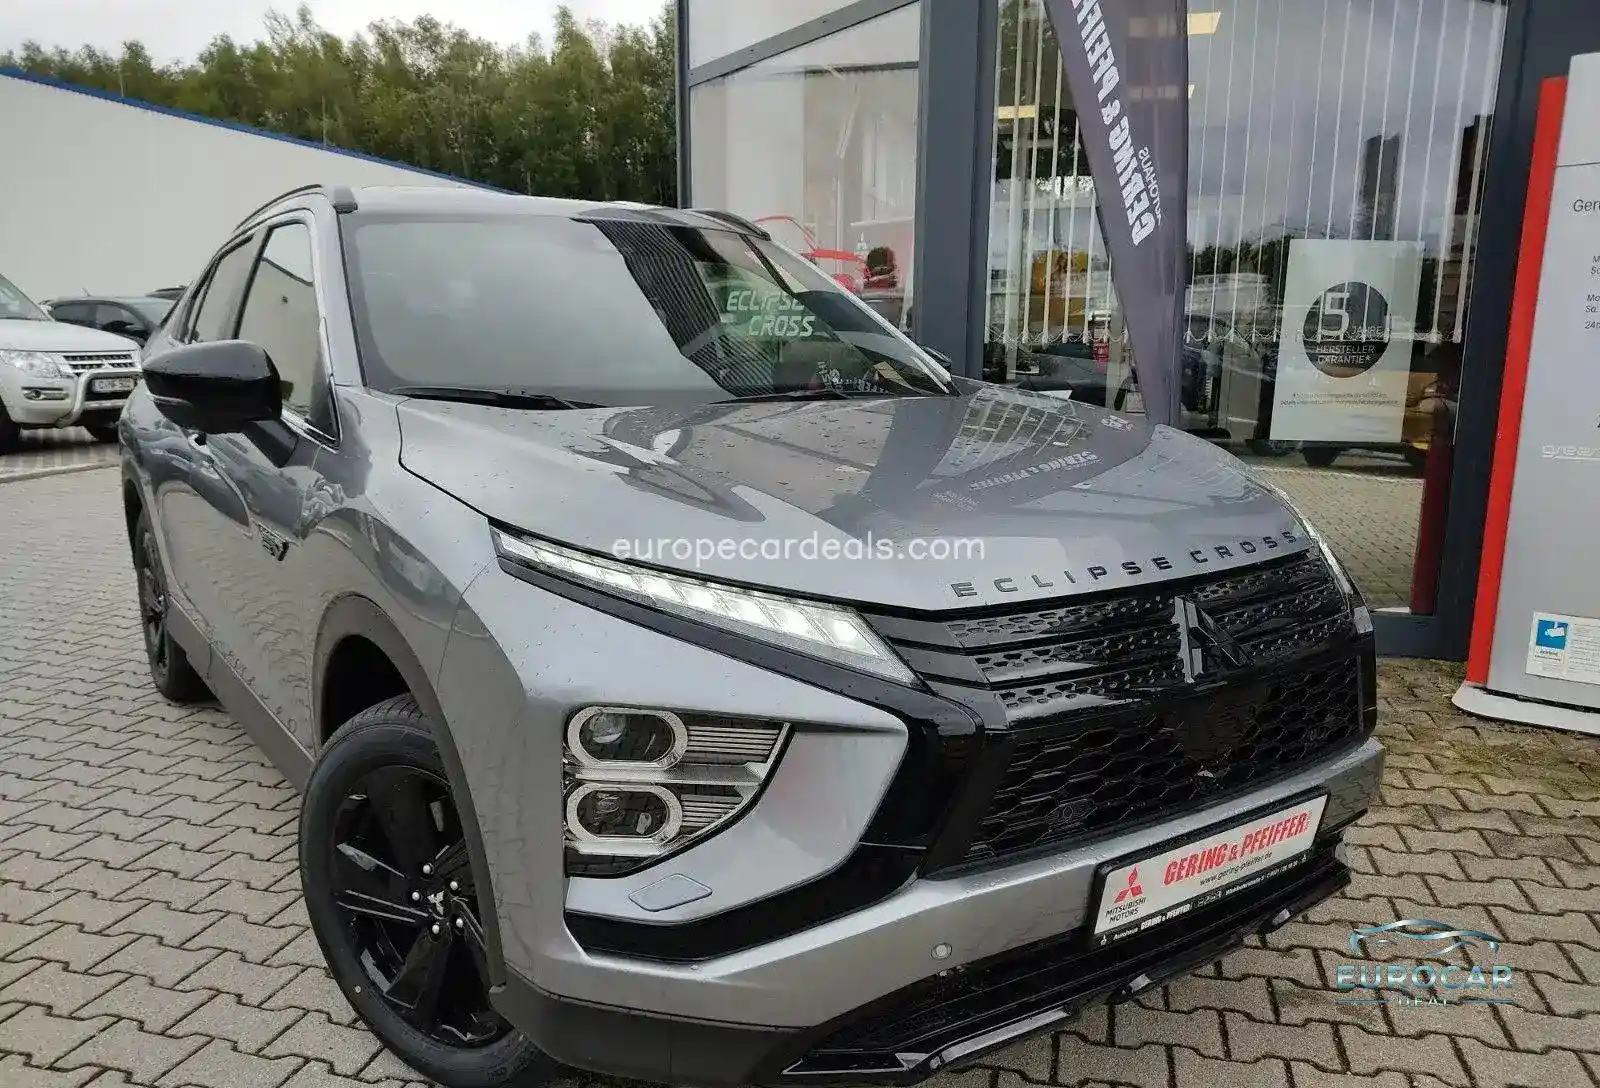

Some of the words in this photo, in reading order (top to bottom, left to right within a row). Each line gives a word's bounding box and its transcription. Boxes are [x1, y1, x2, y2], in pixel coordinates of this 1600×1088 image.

[727, 290, 805, 311] ECLIPSE
[1321, 292, 1350, 337] 5
[749, 315, 816, 337] CROSS
[1316, 344, 1375, 354] HERSTELLER
[950, 556, 1173, 598] ECLIPSE
[1190, 531, 1297, 563] CROSS
[1163, 843, 1228, 886] GERING
[1229, 844, 1239, 861] &
[1241, 812, 1309, 858] PFEIFFER
[1106, 897, 1147, 917] MITSUBISHI
[1109, 906, 1139, 923] MOTORS
